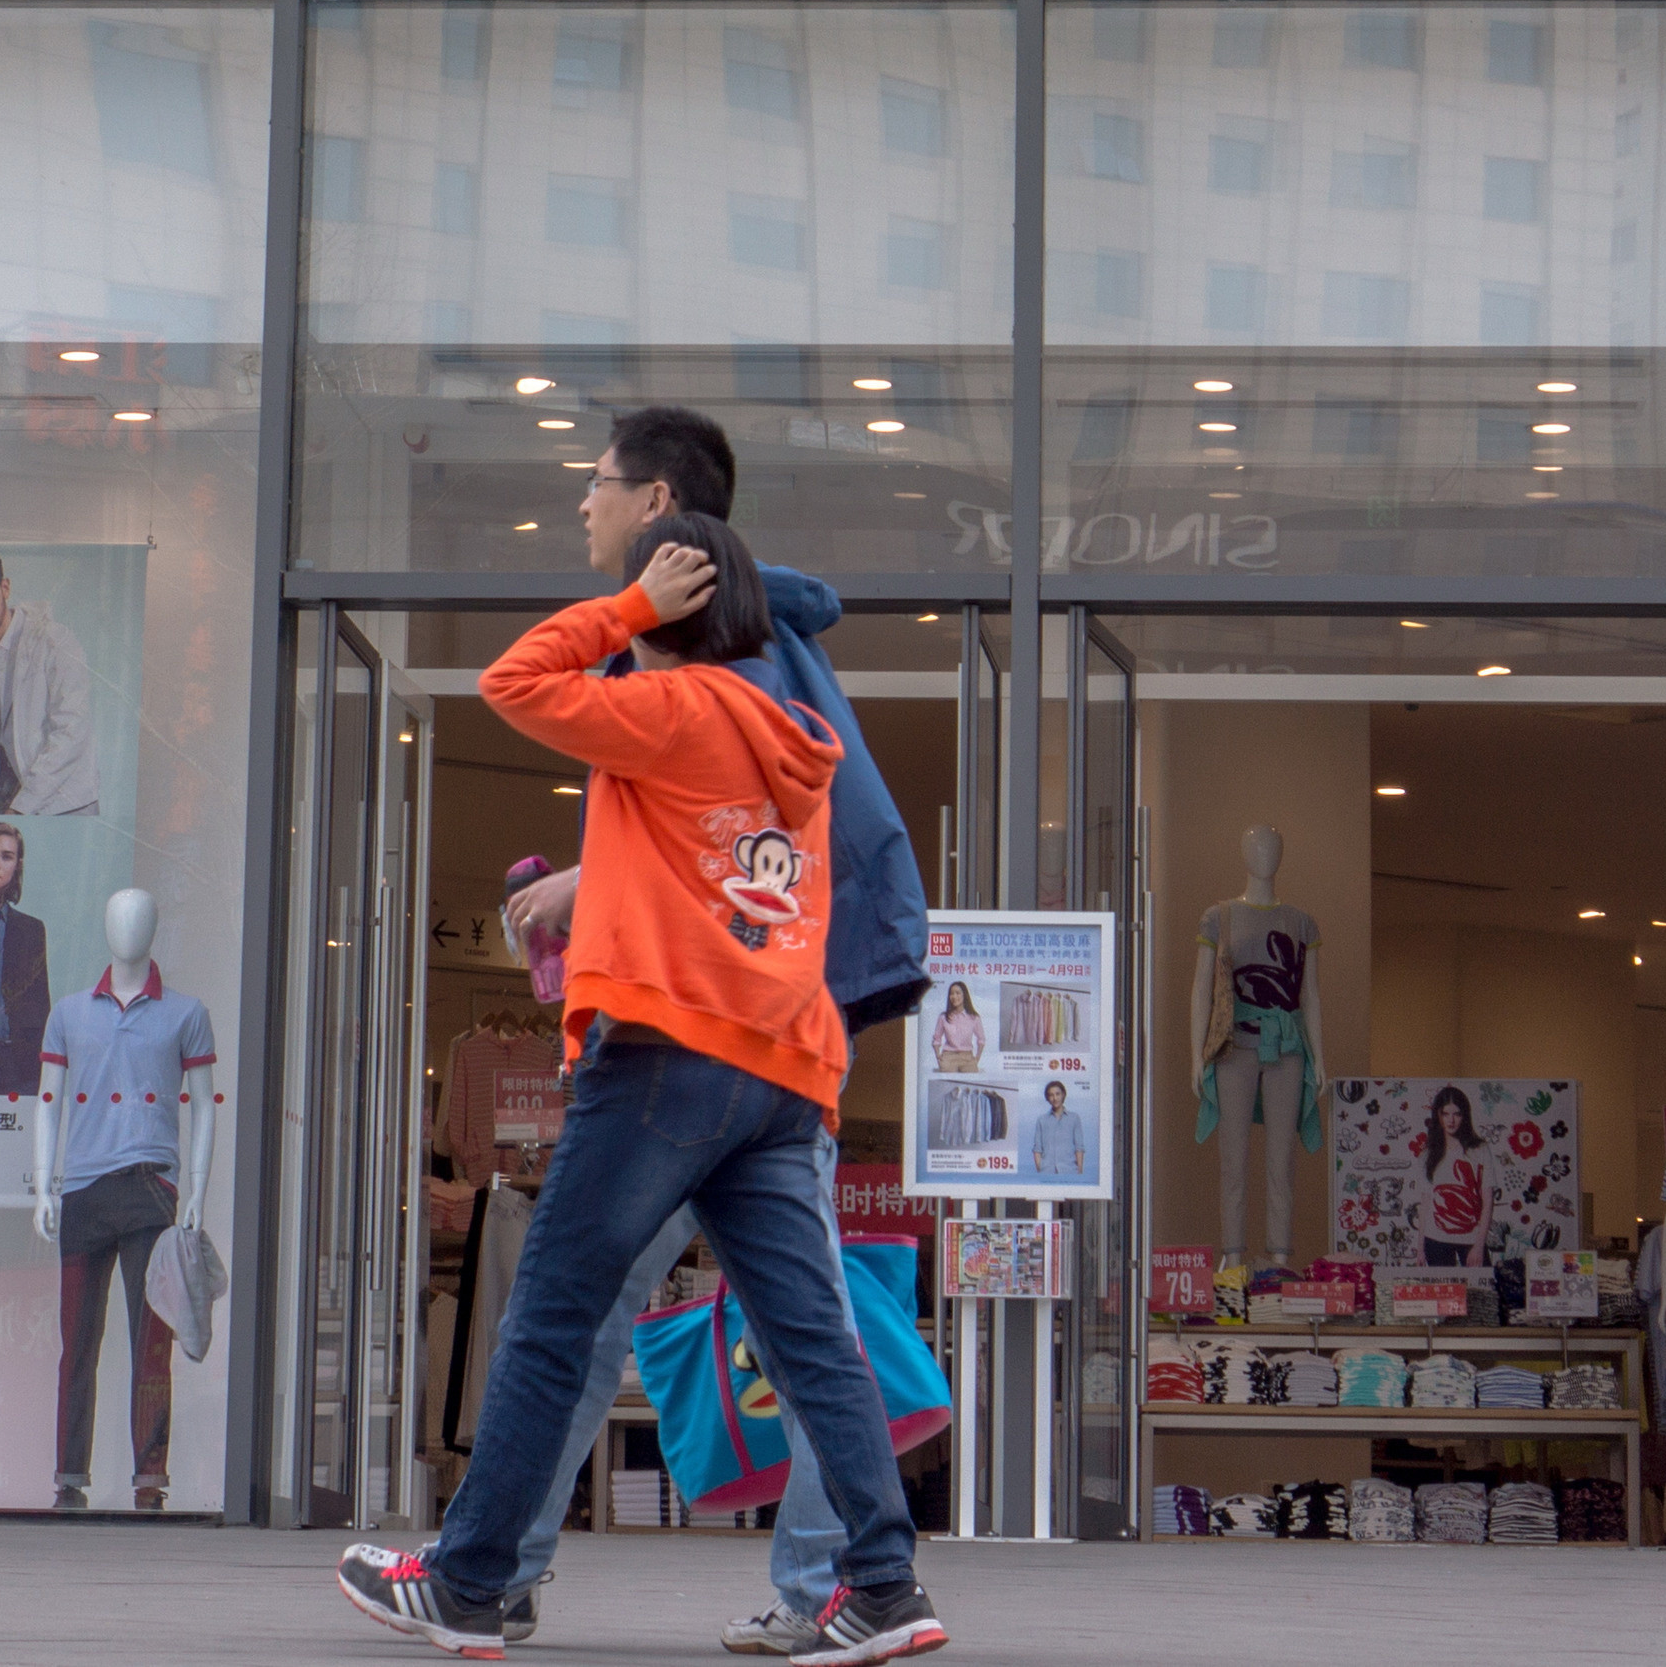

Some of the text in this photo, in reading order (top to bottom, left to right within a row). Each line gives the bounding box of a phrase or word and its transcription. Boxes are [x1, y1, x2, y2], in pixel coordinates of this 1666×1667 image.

[933, 936, 949, 944] UNI
[933, 946, 951, 954] QLO
[929, 963, 979, 975] 限时特优
